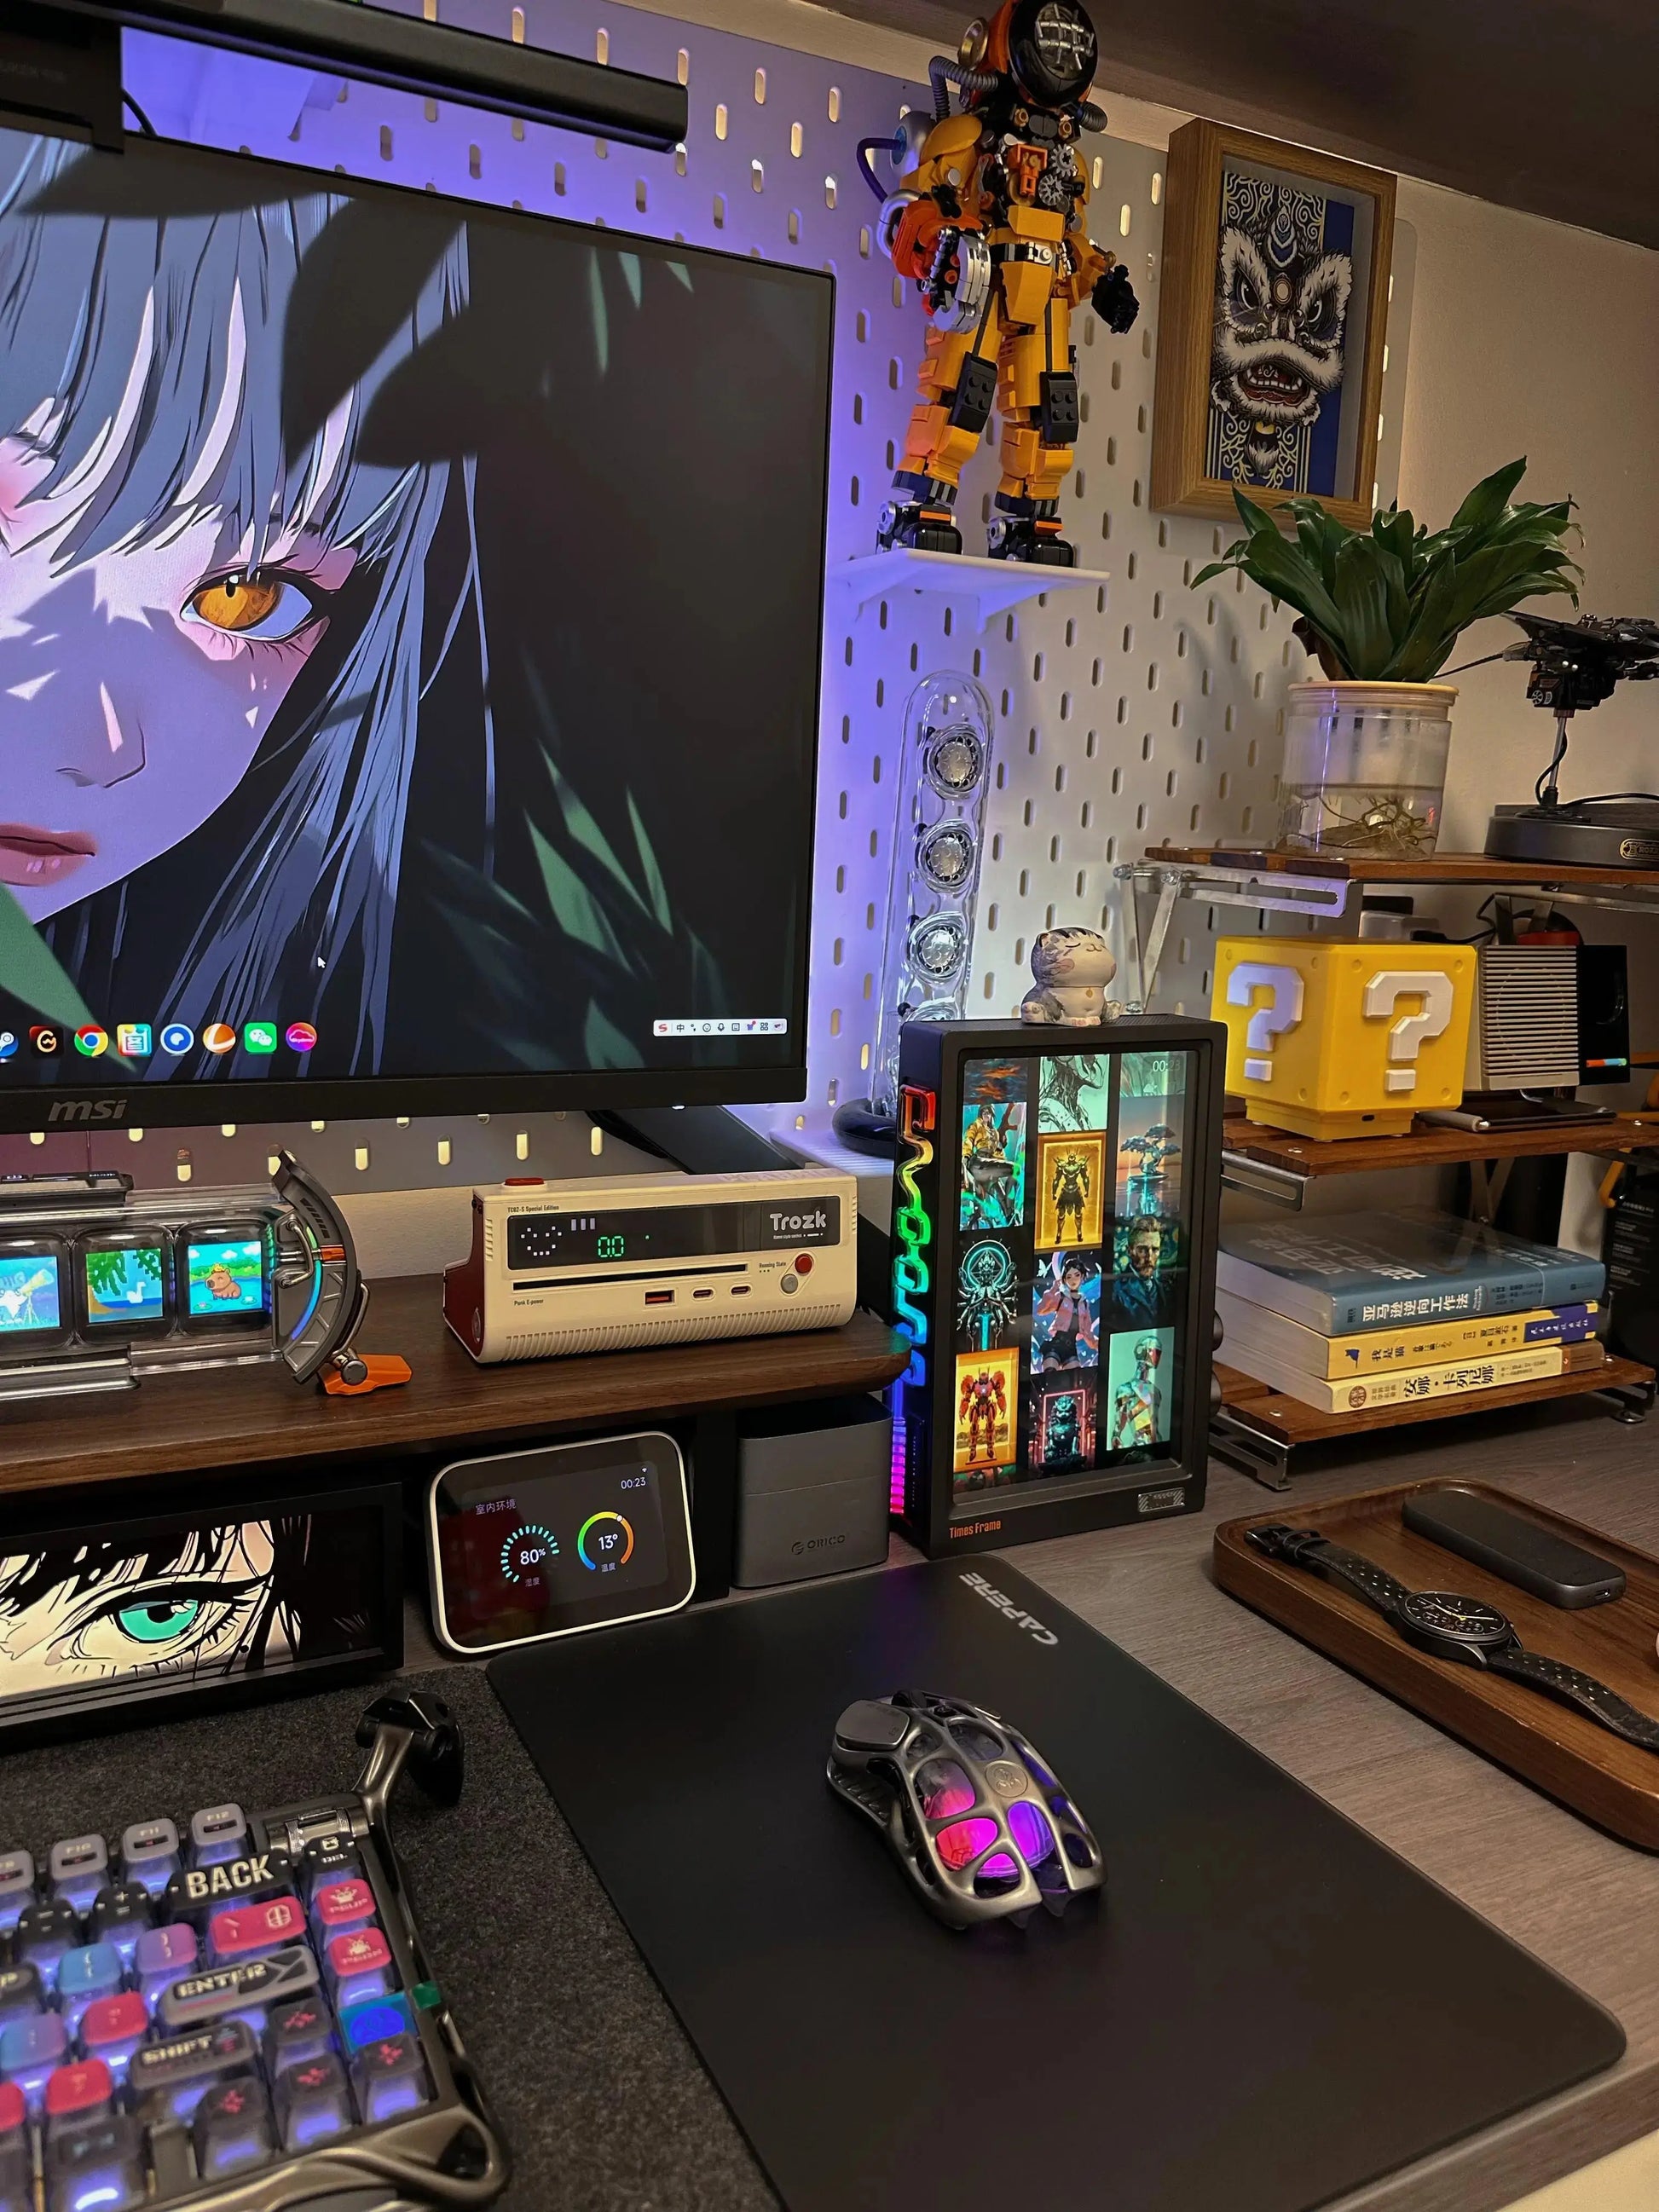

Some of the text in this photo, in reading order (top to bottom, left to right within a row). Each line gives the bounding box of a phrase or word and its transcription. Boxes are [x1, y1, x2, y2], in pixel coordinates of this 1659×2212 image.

[676, 1024, 685, 1033] 中
[1226, 962, 1304, 1082] ?
[1362, 971, 1454, 1092] ?
[48, 1099, 128, 1122] msi
[770, 1210, 826, 1231] Trozk
[598, 1236, 624, 1258] 0.0
[1362, 1293, 1469, 1322] 亚马逊逆向工作法
[1372, 1346, 1405, 1361] 我是猫
[1402, 1365, 1494, 1398] 安娜·卡列尼娜
[621, 1476, 646, 1489] 00:23
[475, 1499, 517, 1516] 室内环境
[949, 1521, 1001, 1539] Times Frame
[807, 1535, 846, 1548] ORICO
[520, 1548, 546, 1565] 80%
[959, 1572, 1059, 1646] CAPERE
[205, 1811, 229, 1822] F12
[140, 1827, 159, 1837] F11
[187, 1854, 274, 1899] BACK
[177, 1964, 267, 1997] ENTER
[142, 2035, 212, 2065] SHIFT
